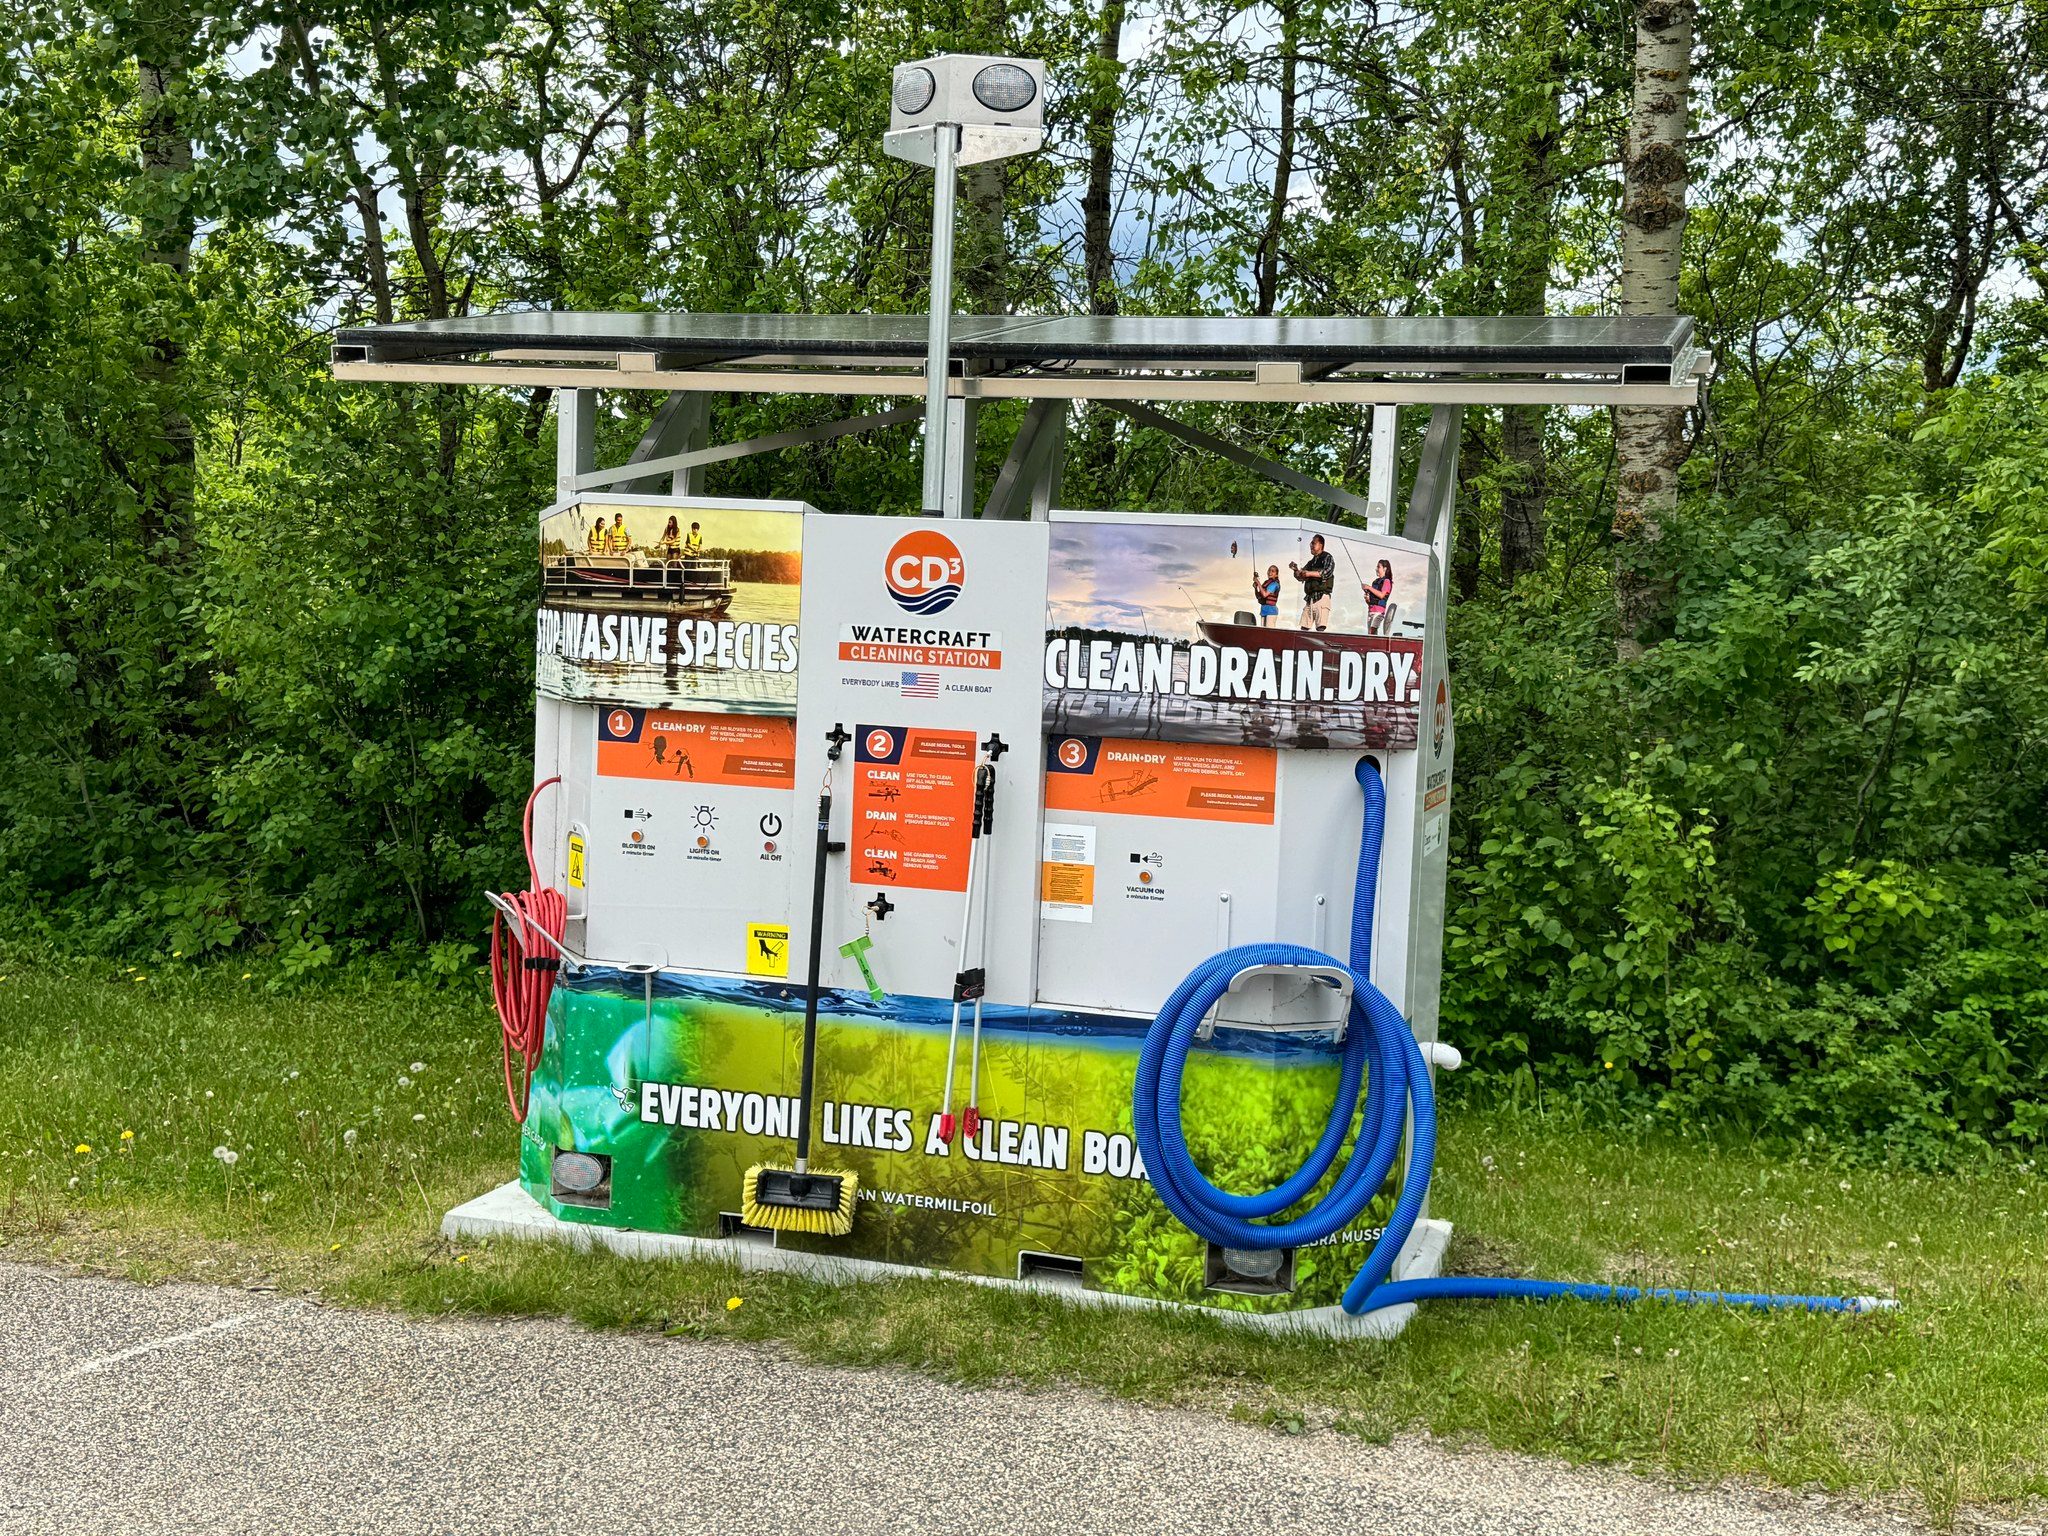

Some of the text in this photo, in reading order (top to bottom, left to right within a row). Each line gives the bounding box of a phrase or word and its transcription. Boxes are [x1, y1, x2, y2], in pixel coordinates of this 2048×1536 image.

[563, 612, 668, 664] INVASIVE
[677, 619, 798, 673] SPECIES
[851, 626, 991, 648] WATERCRAFT
[850, 646, 990, 667] CLEANING STATION
[842, 678, 880, 687] EVERYBODY
[881, 680, 900, 688] LIKES
[951, 684, 974, 693] CLEAN
[615, 715, 626, 730] 1
[873, 735, 886, 752] 2
[1066, 743, 1080, 763] 3
[867, 770, 900, 780] CLEAN
[866, 810, 897, 821] DRAIN
[864, 848, 898, 859] CLEAN
[823, 1101, 913, 1152] LIKES
[1084, 1131, 1151, 1181] BOA
[856, 1190, 997, 1217] AN WATERMILFOIL
[1342, 1227, 1387, 1244] MUSS
